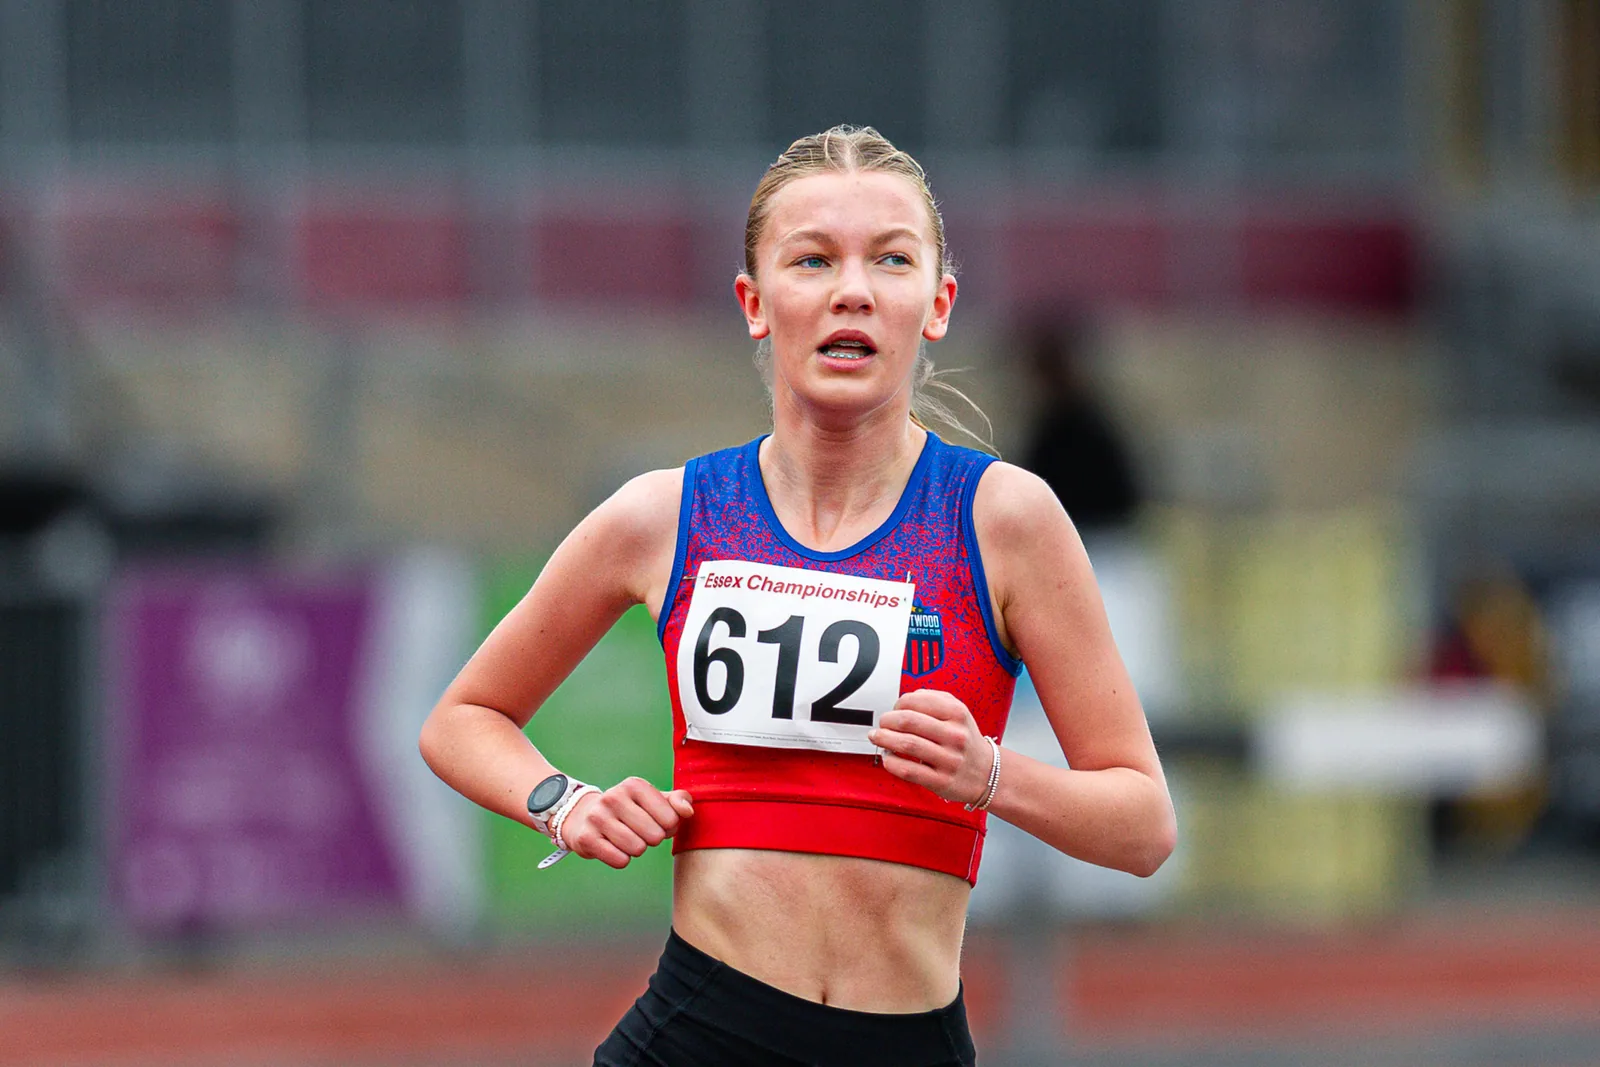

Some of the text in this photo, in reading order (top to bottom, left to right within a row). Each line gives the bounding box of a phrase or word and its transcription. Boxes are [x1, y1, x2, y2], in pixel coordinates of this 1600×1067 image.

[704, 572, 900, 608] Essex Championships
[908, 627, 928, 635] THLETICS
[910, 614, 939, 628] TWOOD
[693, 606, 880, 726] 612
